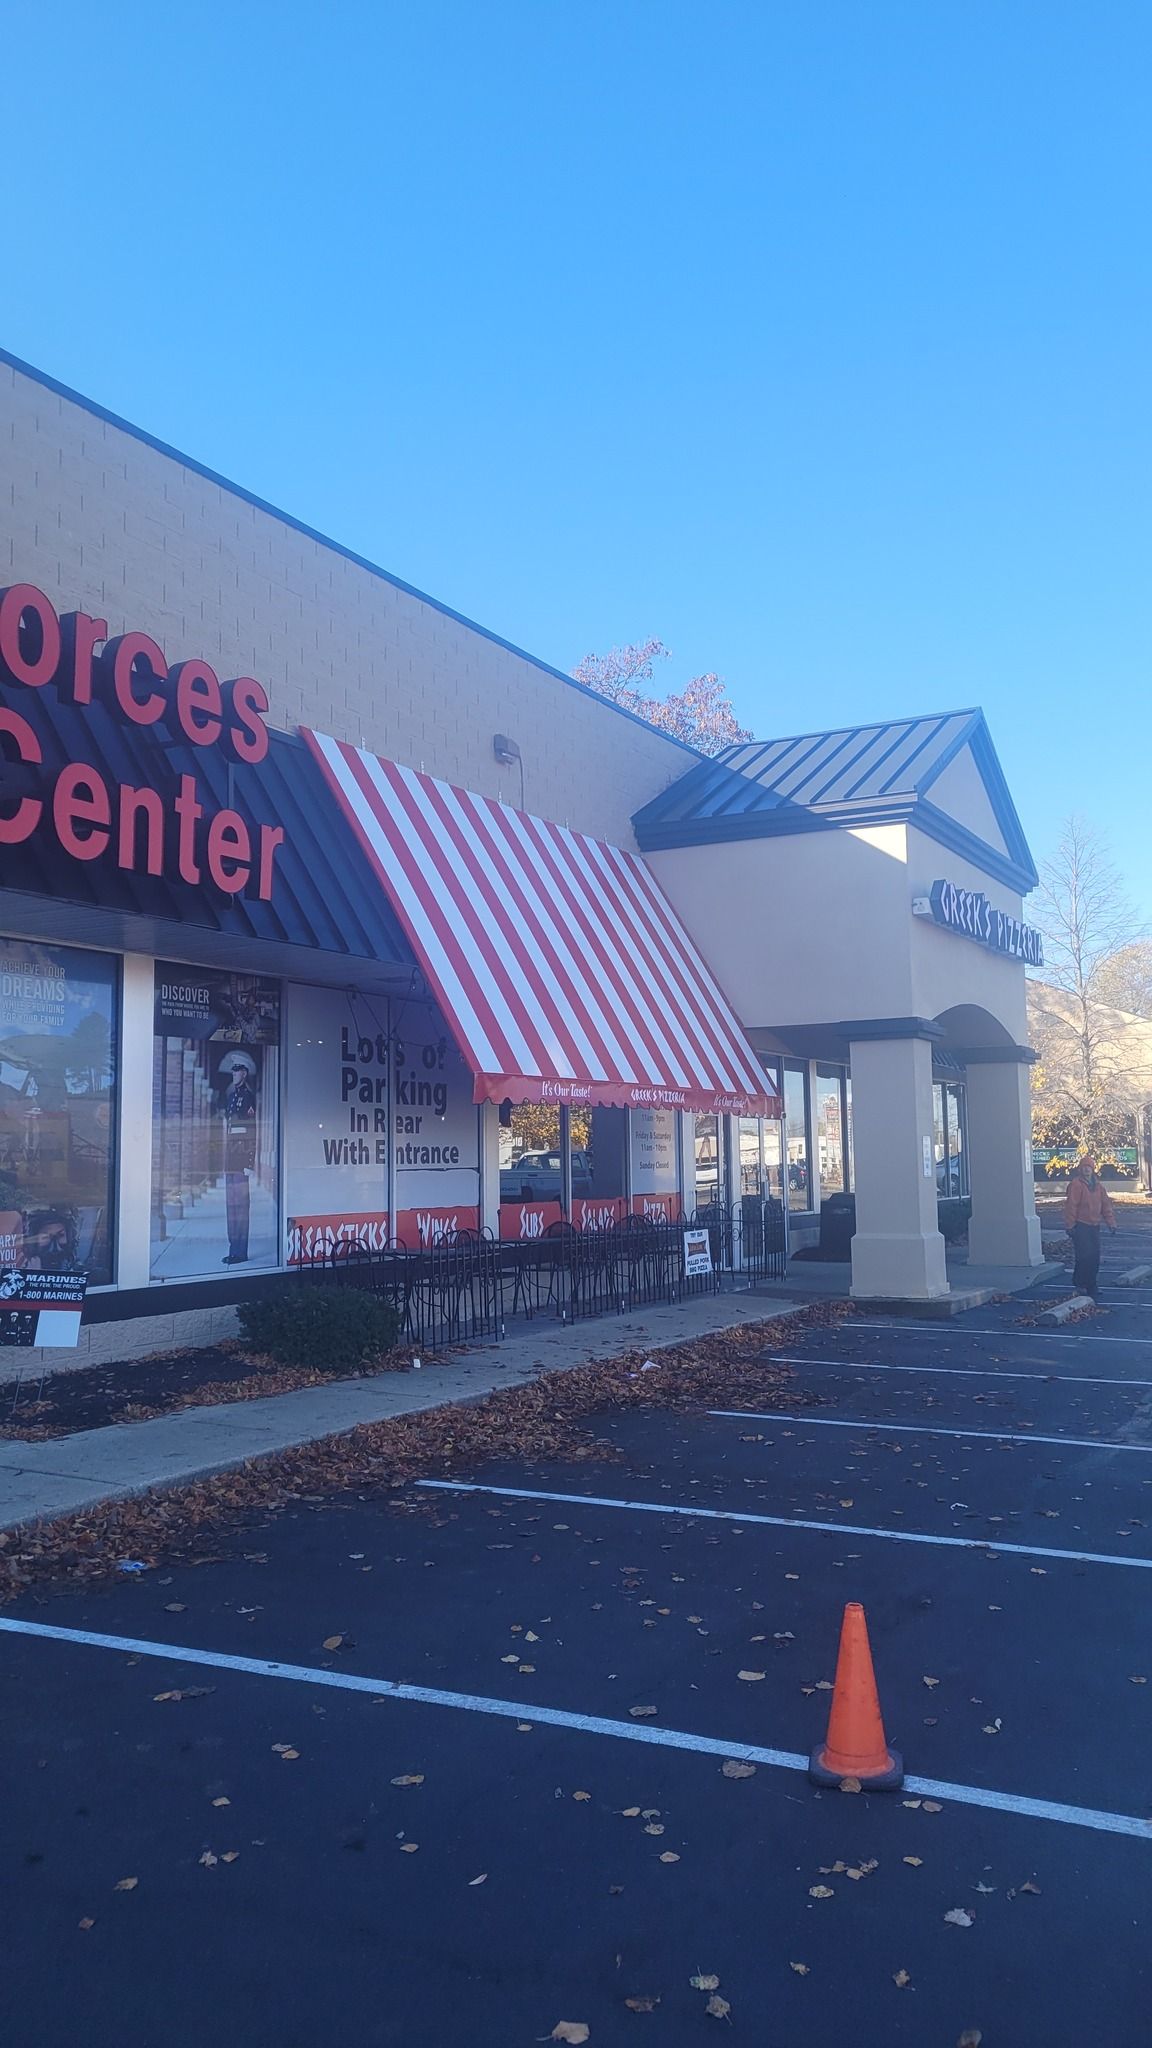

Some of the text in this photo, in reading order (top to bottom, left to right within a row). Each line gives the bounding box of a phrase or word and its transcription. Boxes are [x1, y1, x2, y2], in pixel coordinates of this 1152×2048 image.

[997, 909, 1043, 965] PIZZERIA
[2, 960, 65, 979] ACHIEVE YOUR
[2, 975, 65, 1002] DREAMS
[161, 984, 210, 1005] DISCOVER
[40, 1015, 65, 1026] FAMILY
[341, 1026, 406, 1068] Lots
[341, 1067, 448, 1116] Parking
[542, 1081, 592, 1098] It's Our Taste!
[630, 1088, 686, 1104] GREEK'S PIZZERIA
[722, 1095, 732, 1107] Our
[350, 1107, 422, 1134] In Rear
[635, 1132, 649, 1141] Friday
[323, 1138, 459, 1165] With Entrance
[639, 1161, 669, 1171] Sunday Closed
[581, 1200, 615, 1231] SALADS
[643, 1198, 667, 1225] PIZZA
[520, 1205, 544, 1239] SUBS
[0, 1249, 17, 1261] YOU
[687, 1258, 699, 1266] PULLED
[25, 1274, 87, 1284] MARINES
[19, 1290, 83, 1301] 1-800 MARINES
